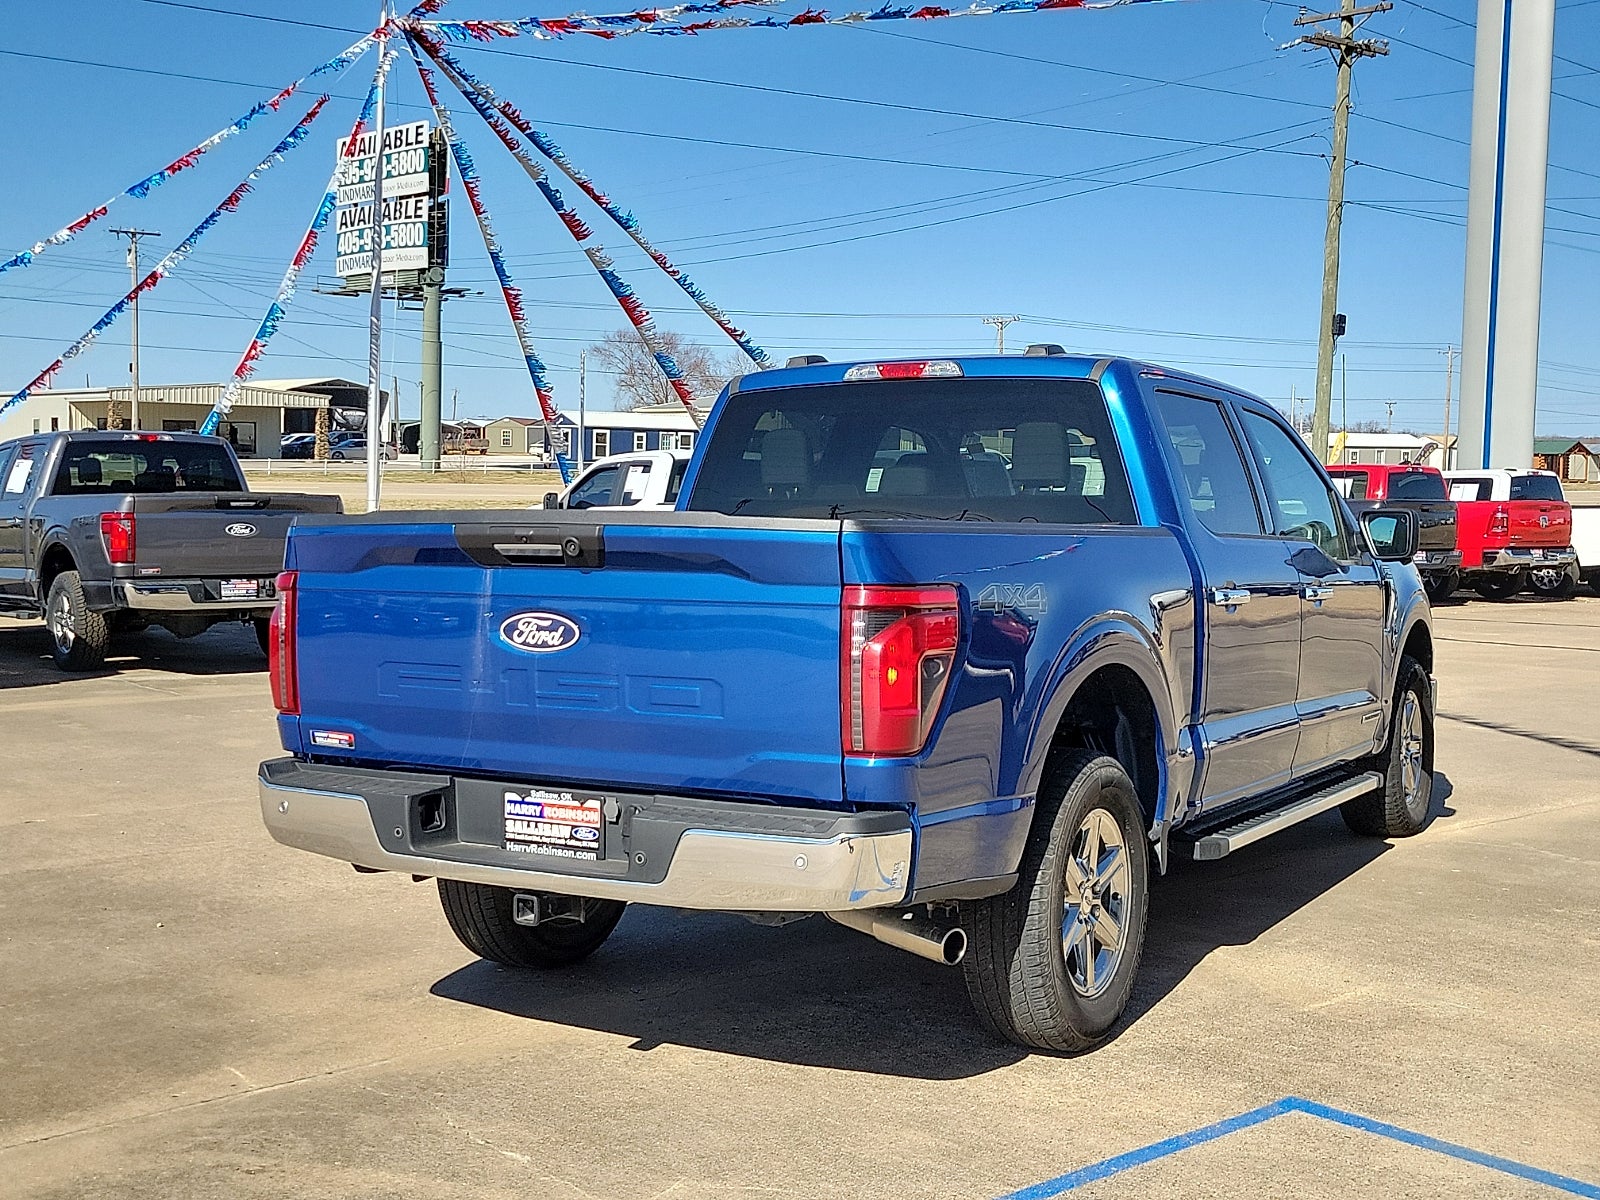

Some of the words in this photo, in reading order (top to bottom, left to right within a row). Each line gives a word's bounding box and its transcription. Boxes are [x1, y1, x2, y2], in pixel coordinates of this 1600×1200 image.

[340, 124, 425, 161] AAIABLE
[340, 148, 425, 185] 05-9-5800
[339, 199, 424, 231] AVAIABLE
[338, 223, 424, 256] 405-9-5800
[513, 618, 565, 646] Ford
[507, 802, 542, 817] HARRY
[544, 806, 599, 823] ROBINSON
